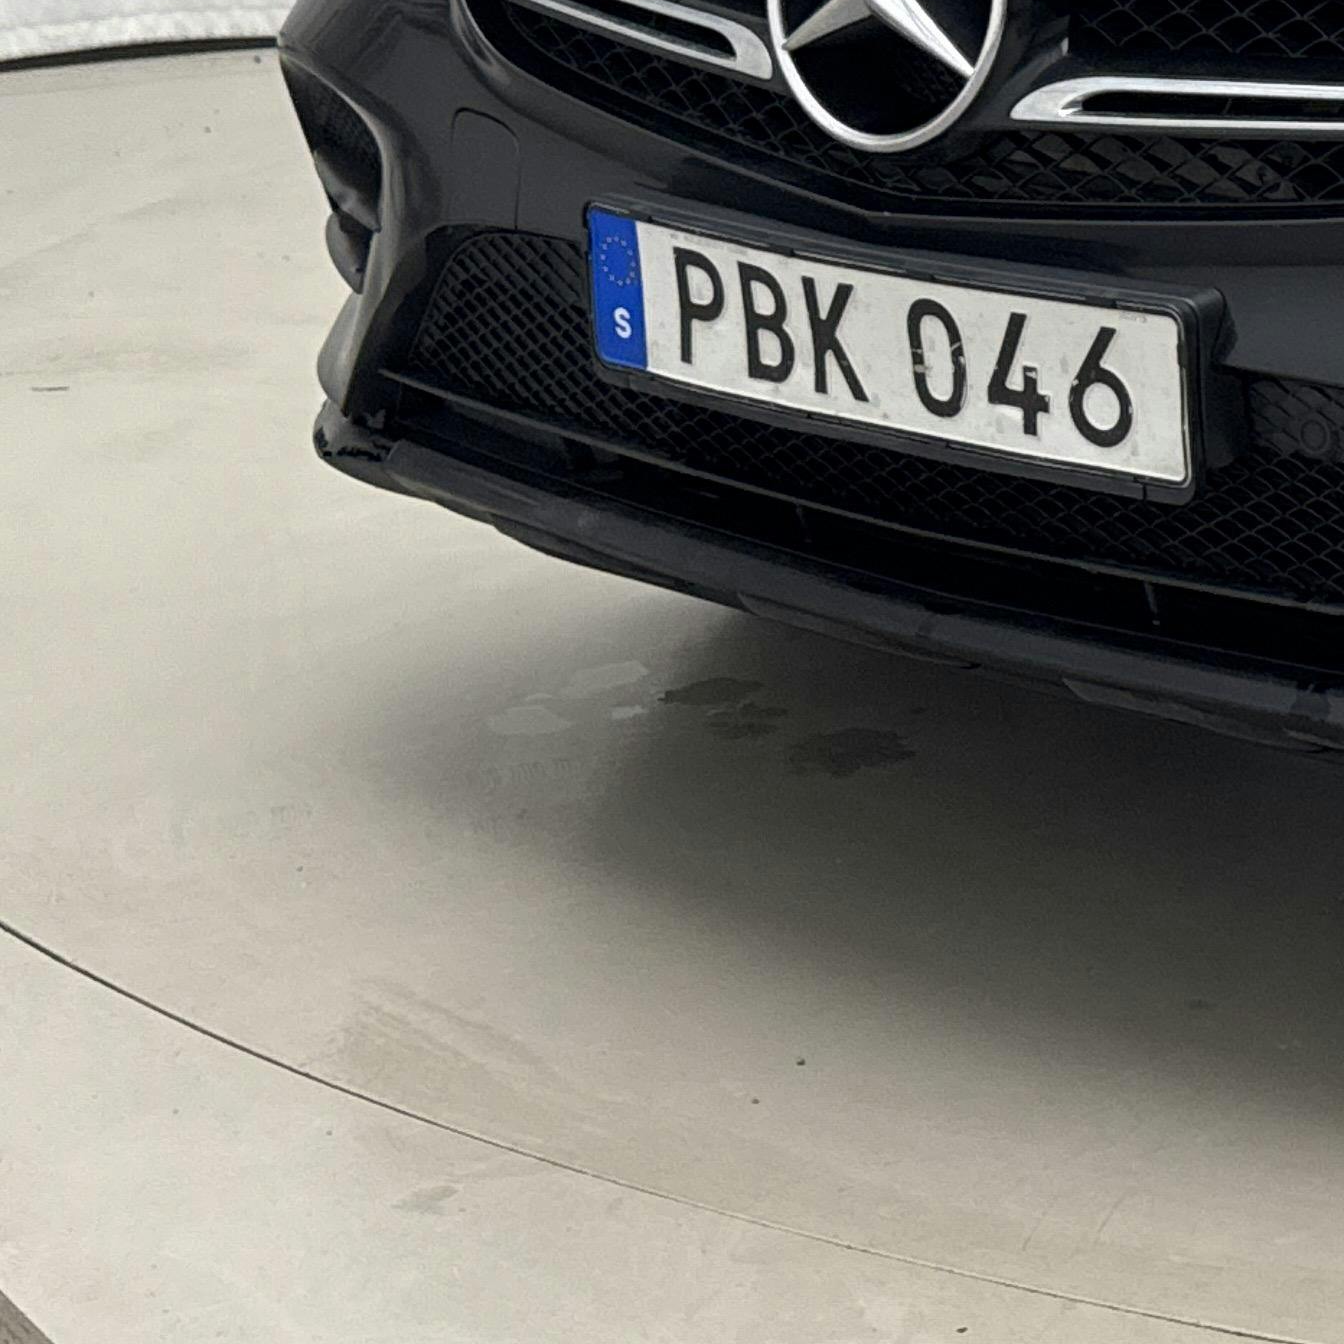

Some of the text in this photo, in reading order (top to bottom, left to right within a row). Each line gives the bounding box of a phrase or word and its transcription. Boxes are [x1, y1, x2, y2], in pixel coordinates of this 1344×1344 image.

[613, 306, 632, 339] S
[673, 246, 1133, 449] PBK 046
